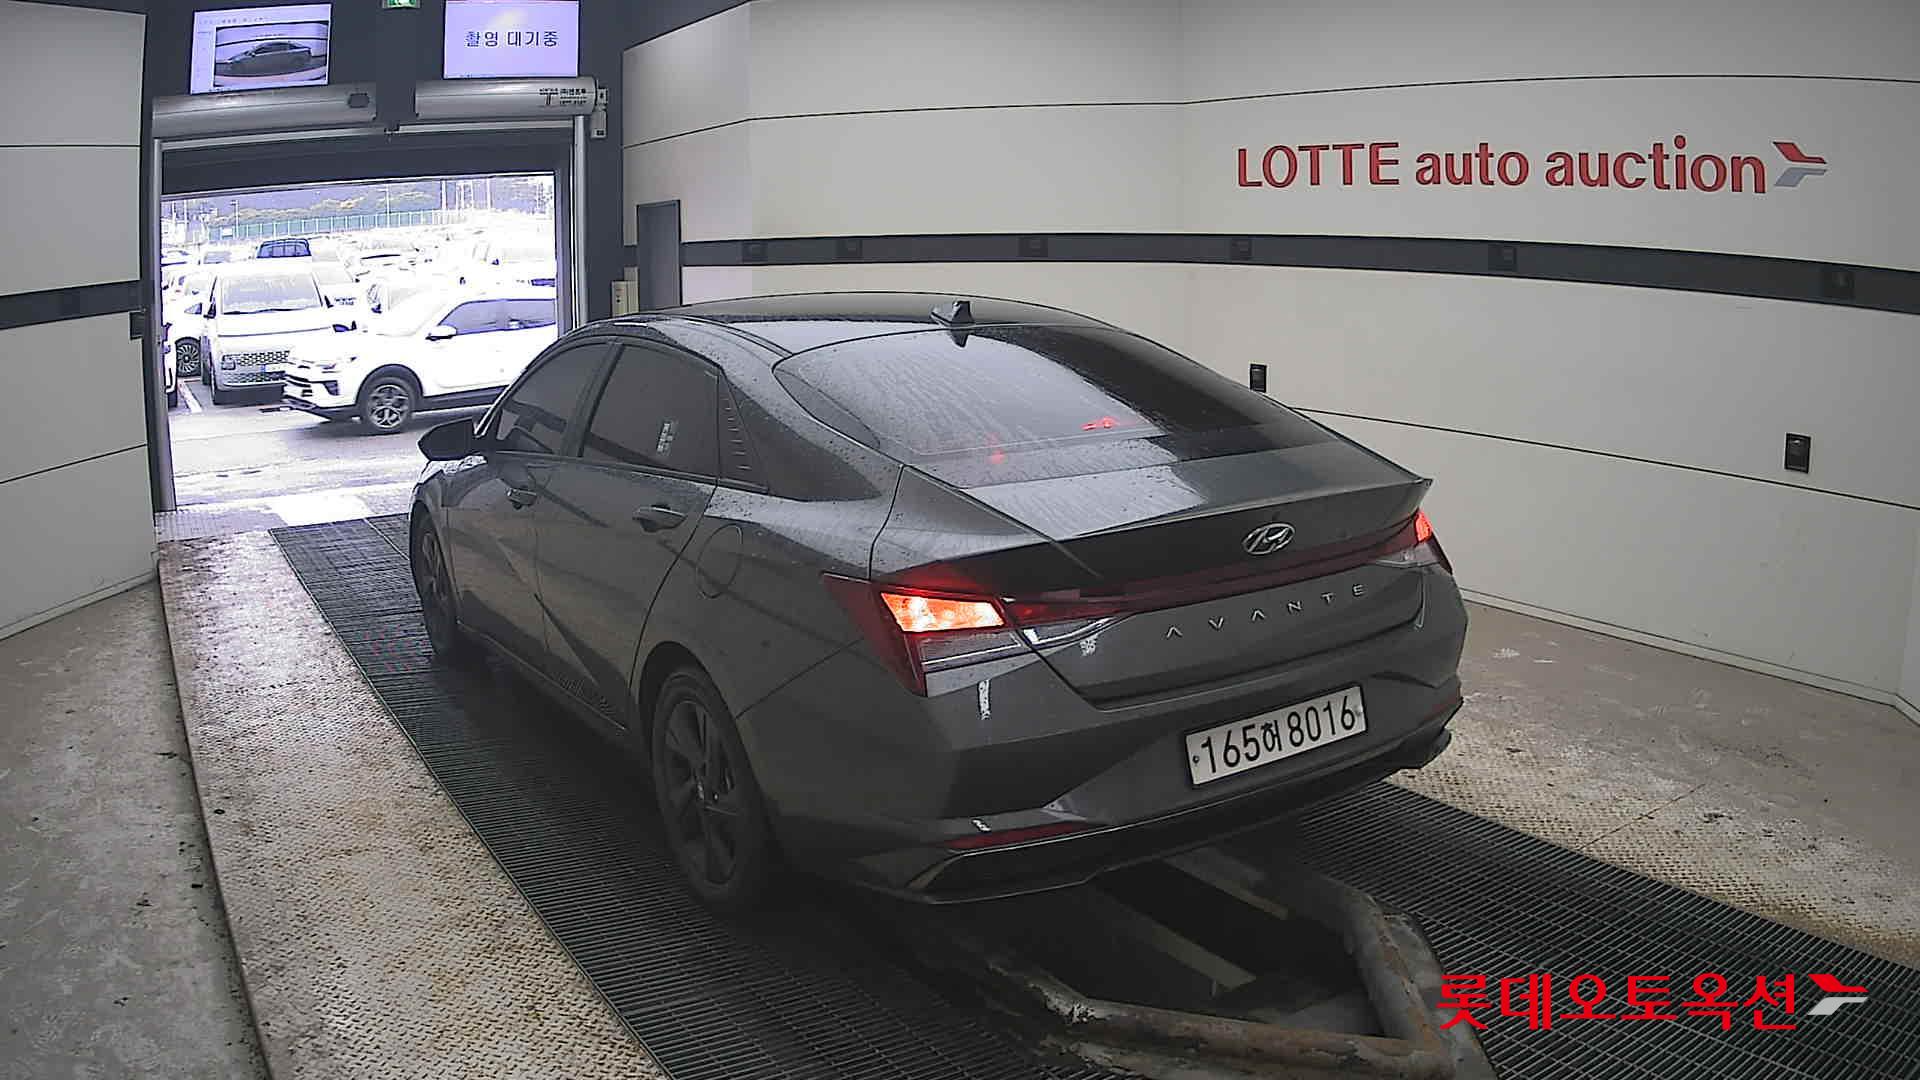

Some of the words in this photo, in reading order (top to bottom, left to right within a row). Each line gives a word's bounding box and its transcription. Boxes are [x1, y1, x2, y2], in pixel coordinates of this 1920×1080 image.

[506, 31, 559, 47] 대기중
[1237, 141, 1400, 188] LOTTE
[1415, 142, 1529, 187] auto
[1544, 135, 1767, 194] auction
[1165, 584, 1366, 639] AVANTE
